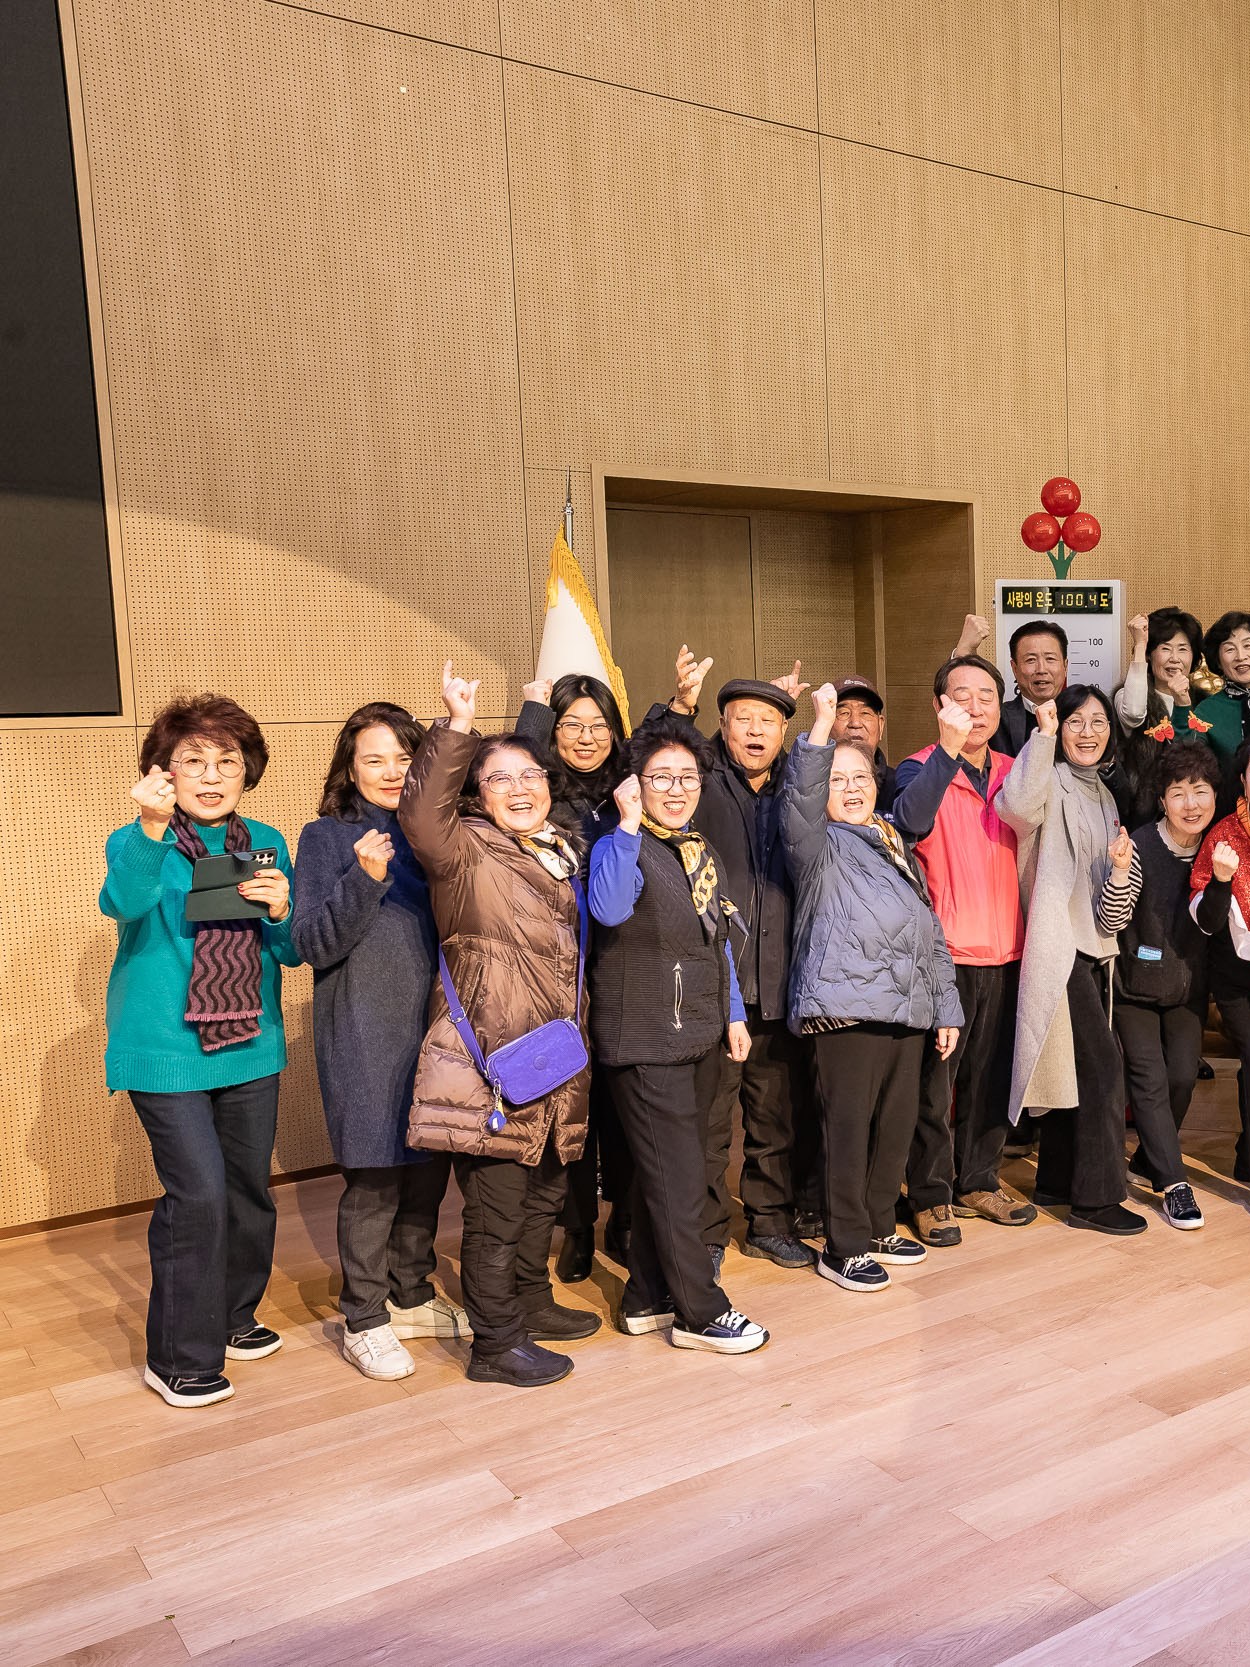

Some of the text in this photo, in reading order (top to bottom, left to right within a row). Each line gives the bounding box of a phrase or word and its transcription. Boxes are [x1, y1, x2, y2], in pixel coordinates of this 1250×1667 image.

[1006, 591, 1109, 608] 사랑의 온도 100.4 도
[1088, 638, 1103, 646] 100
[1089, 660, 1100, 668] 90
